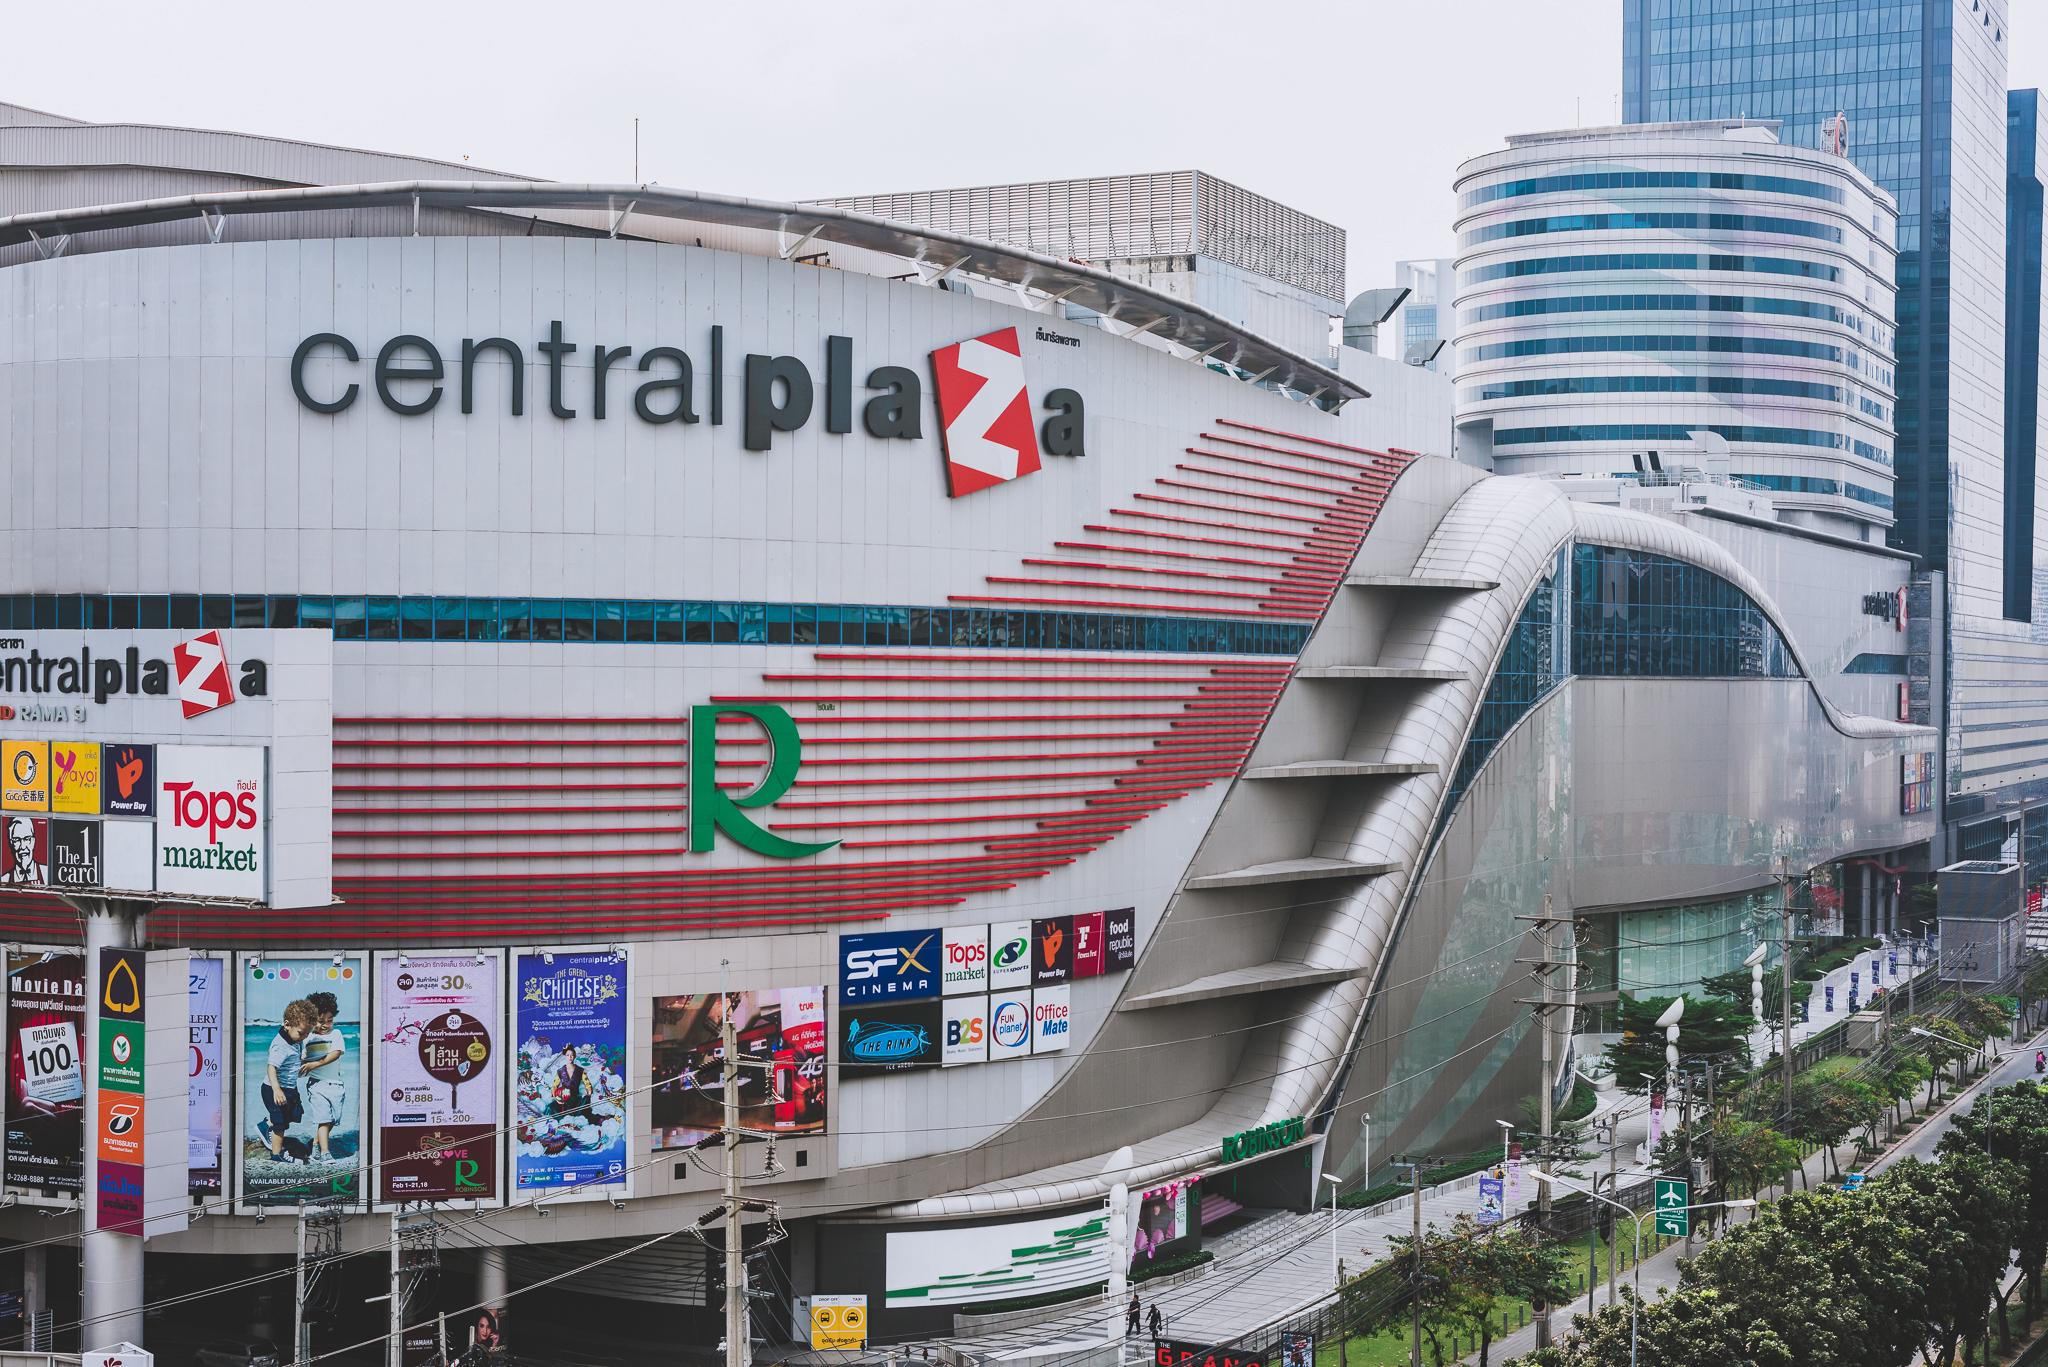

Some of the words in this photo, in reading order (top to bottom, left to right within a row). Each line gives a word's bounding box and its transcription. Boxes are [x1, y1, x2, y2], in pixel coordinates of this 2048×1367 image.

[291, 321, 1086, 480] centralplaza
[20, 705, 68, 722] RAMA
[74, 705, 86, 723] 9
[55, 749, 98, 795] Yayoi
[689, 705, 843, 859] R
[111, 801, 132, 810] Power
[134, 801, 147, 812] Buy
[163, 781, 257, 844] Tops
[56, 845, 80, 865] The
[80, 826, 92, 866] 1
[163, 841, 257, 872] market
[58, 856, 99, 884] card
[1110, 919, 1129, 936] food
[1108, 935, 1133, 953] republic
[847, 934, 935, 980] SFX
[945, 943, 986, 969] Tops
[252, 962, 353, 984] babyshop
[557, 969, 566, 978] THE
[568, 968, 587, 977] GREAT
[945, 966, 986, 982] market
[1039, 971, 1055, 979] Power
[1055, 968, 1066, 977] Buy
[11, 976, 59, 994] Movie
[542, 977, 600, 999] CHINESE
[847, 980, 928, 996] CINEMA
[799, 1002, 814, 1011] true
[1035, 1004, 1068, 1021] Office
[190, 1015, 218, 1023] LERY
[1000, 1014, 1015, 1024] FUN
[1043, 1019, 1068, 1036] Mate
[33, 1026, 66, 1043] ทุกวันพุธ
[189, 1027, 218, 1043] ET
[947, 1017, 983, 1046] B2S
[1000, 1023, 1023, 1035] planet
[437, 1046, 459, 1057] ล้าน
[862, 1042, 882, 1053] THE
[886, 1038, 914, 1051] RINK
[28, 1043, 78, 1077] 100.-
[424, 1044, 436, 1067] 1
[798, 1055, 824, 1079] 4G
[405, 1094, 433, 1104] 8,888
[1223, 1115, 1305, 1165] ROBINSON
[7, 1173, 44, 1183] 0-2268-8888
[190, 1178, 221, 1188] alplaza
[1160, 1341, 1170, 1349] THE
[1157, 1348, 1261, 1367] GRAN
